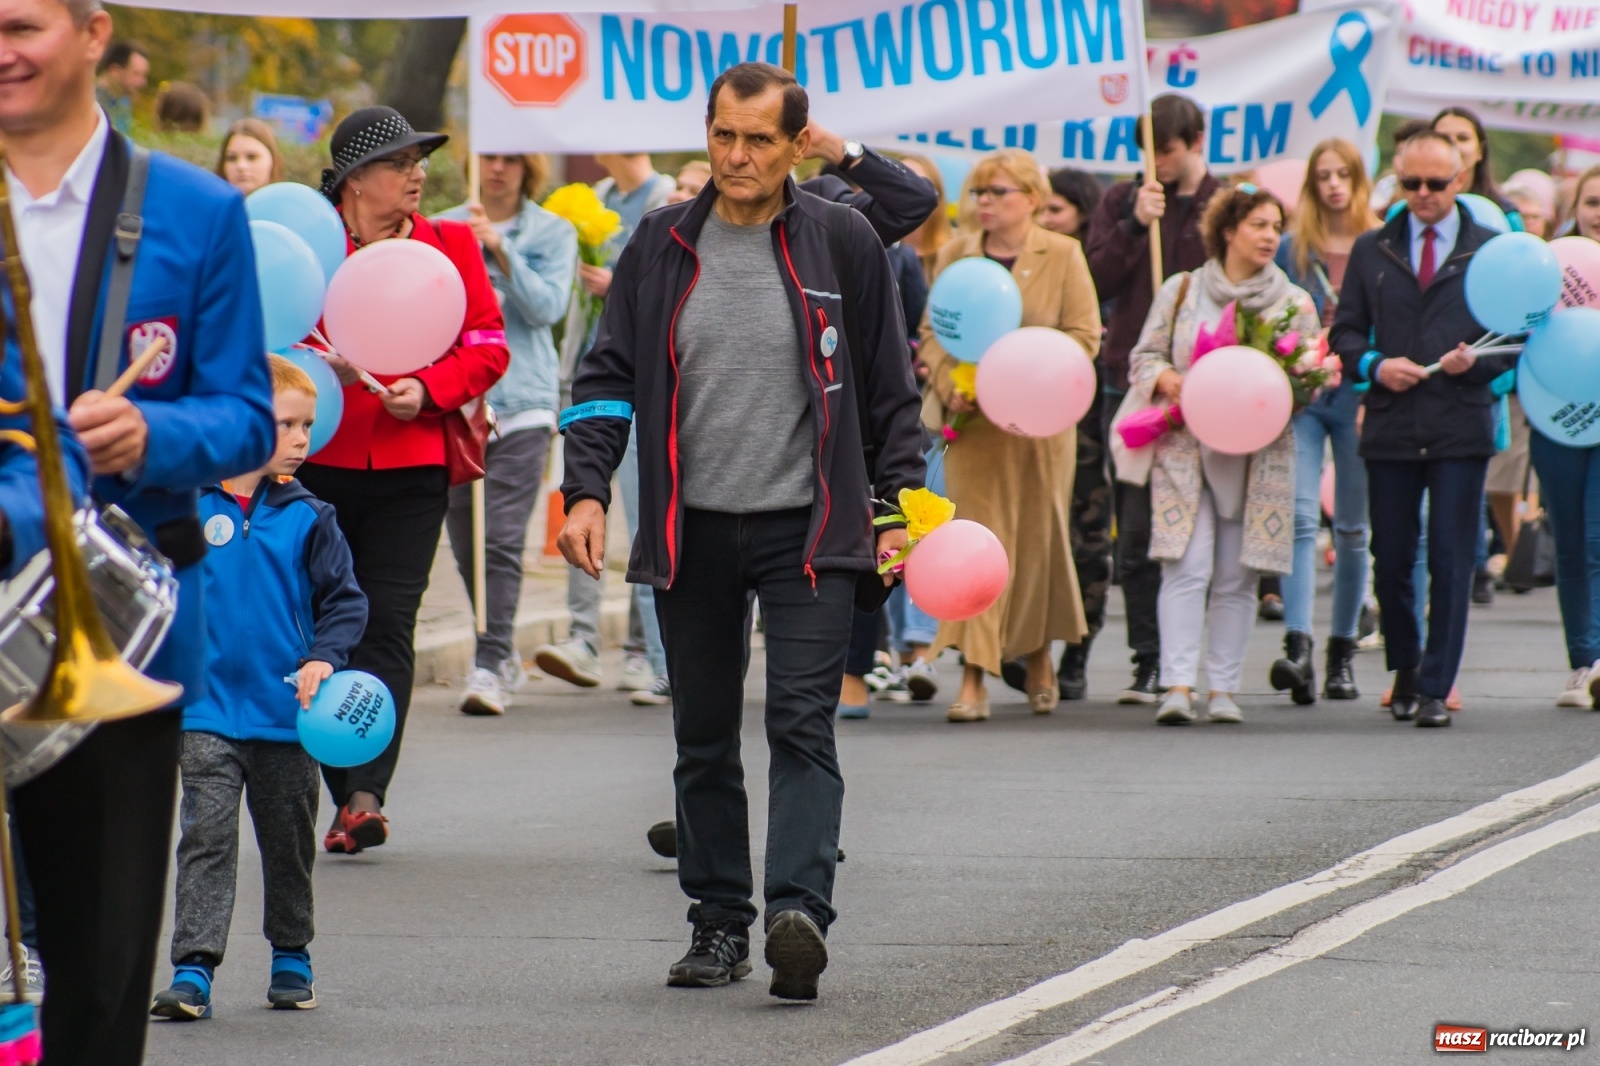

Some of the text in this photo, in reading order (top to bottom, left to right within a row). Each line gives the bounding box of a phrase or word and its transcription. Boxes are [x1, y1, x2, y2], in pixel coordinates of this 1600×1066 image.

[494, 32, 576, 77] STOP
[1519, 51, 1555, 77] TO
[333, 681, 363, 721] RAKIEM
[348, 689, 374, 725] PRZED
[355, 693, 384, 739] ZDĄŻYĆ
